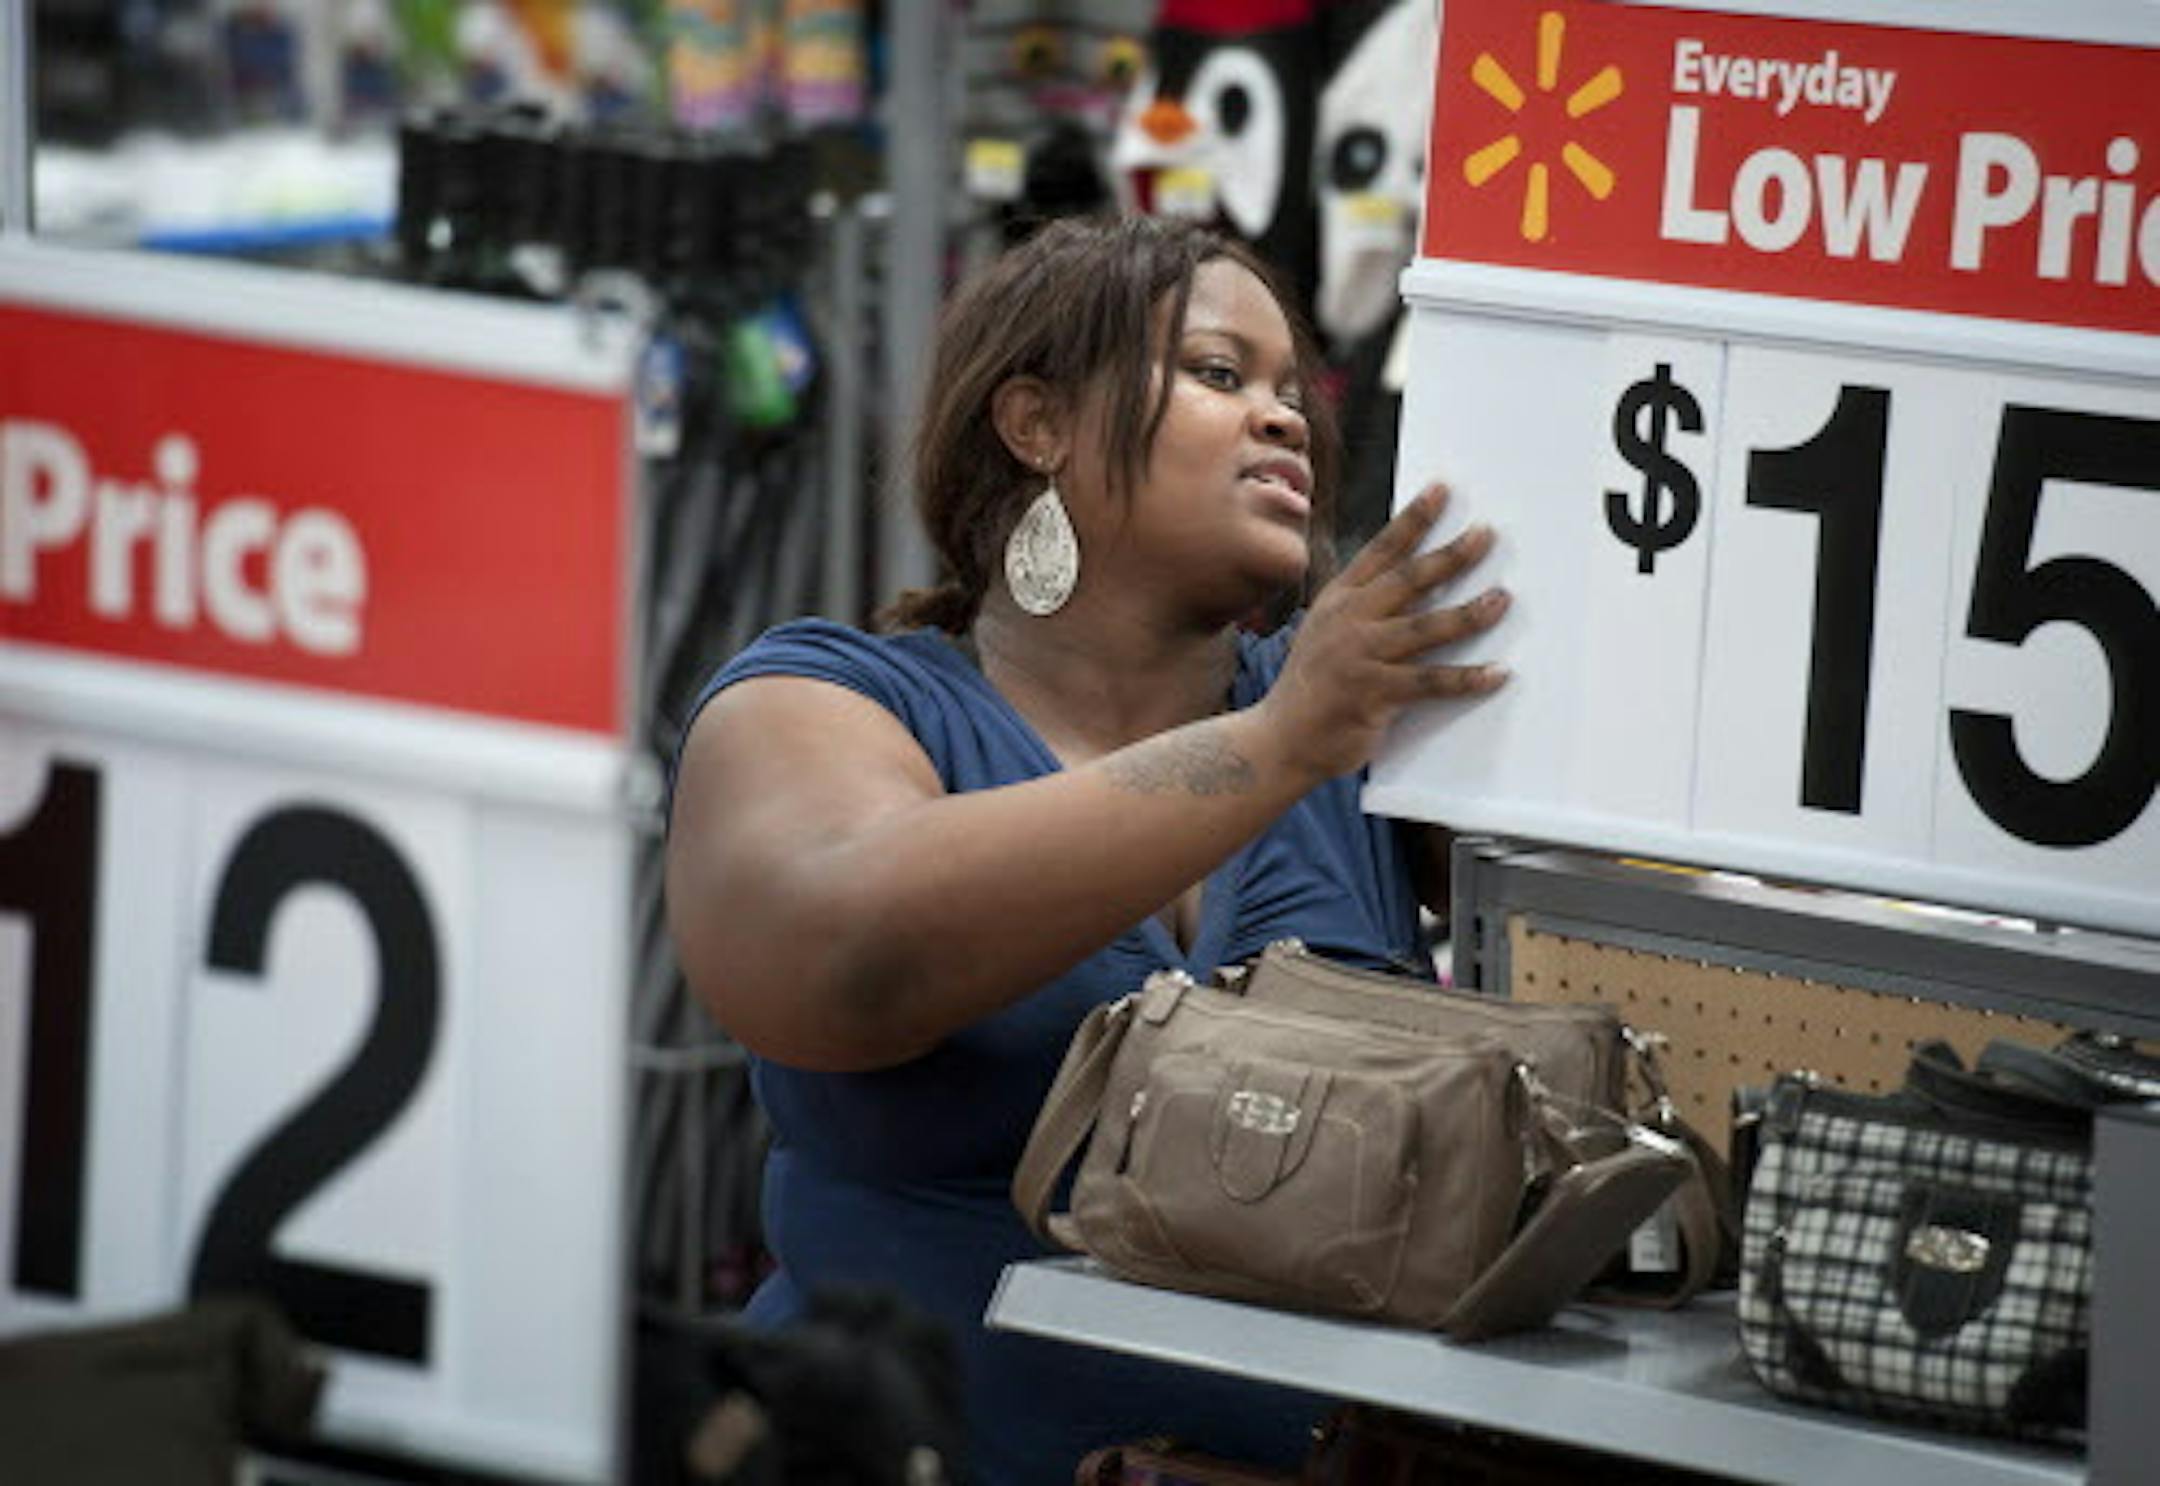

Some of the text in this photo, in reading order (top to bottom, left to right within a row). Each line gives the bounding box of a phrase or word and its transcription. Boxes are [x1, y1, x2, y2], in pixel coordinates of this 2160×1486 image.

[1673, 39, 1896, 123] Everyday
[1659, 104, 1929, 263] Low
[0, 421, 367, 656] Price
[0, 756, 443, 1367] 12
